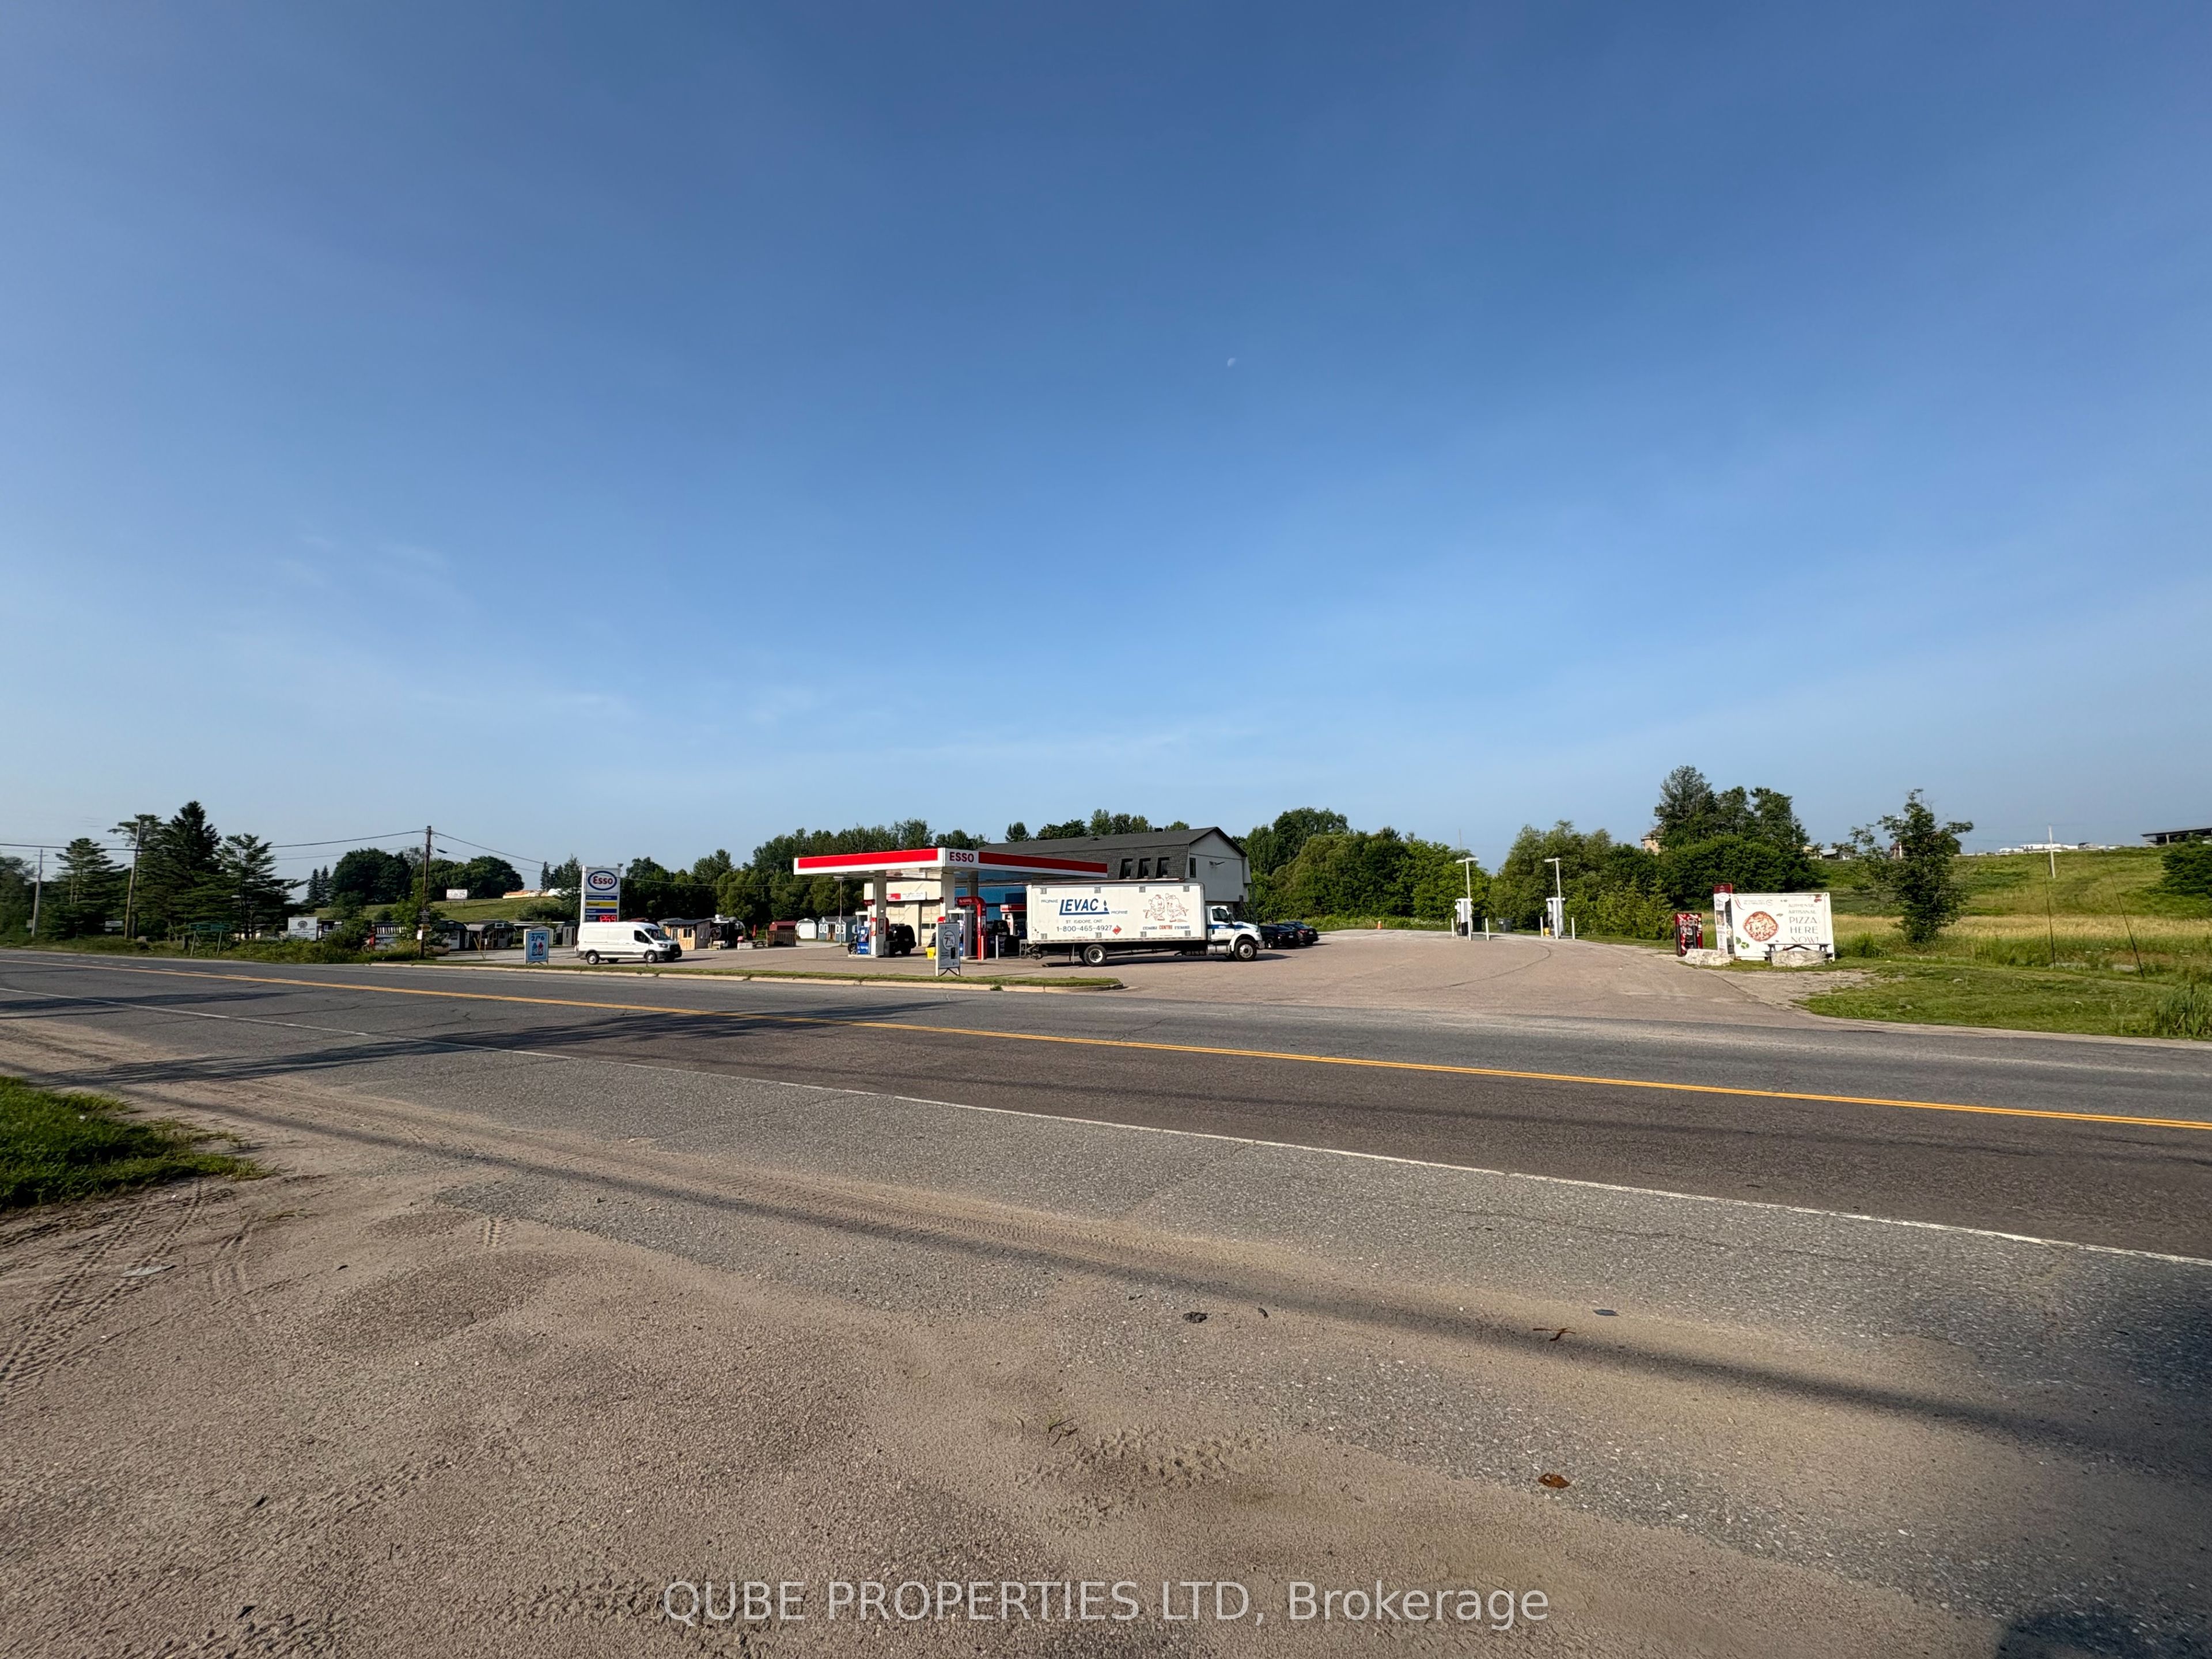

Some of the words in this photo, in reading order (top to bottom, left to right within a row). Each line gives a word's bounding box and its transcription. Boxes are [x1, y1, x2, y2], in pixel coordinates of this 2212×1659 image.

[949, 852, 974, 862] ESSO
[593, 876, 613, 884] Esso
[1059, 898, 1109, 916] LEVAC
